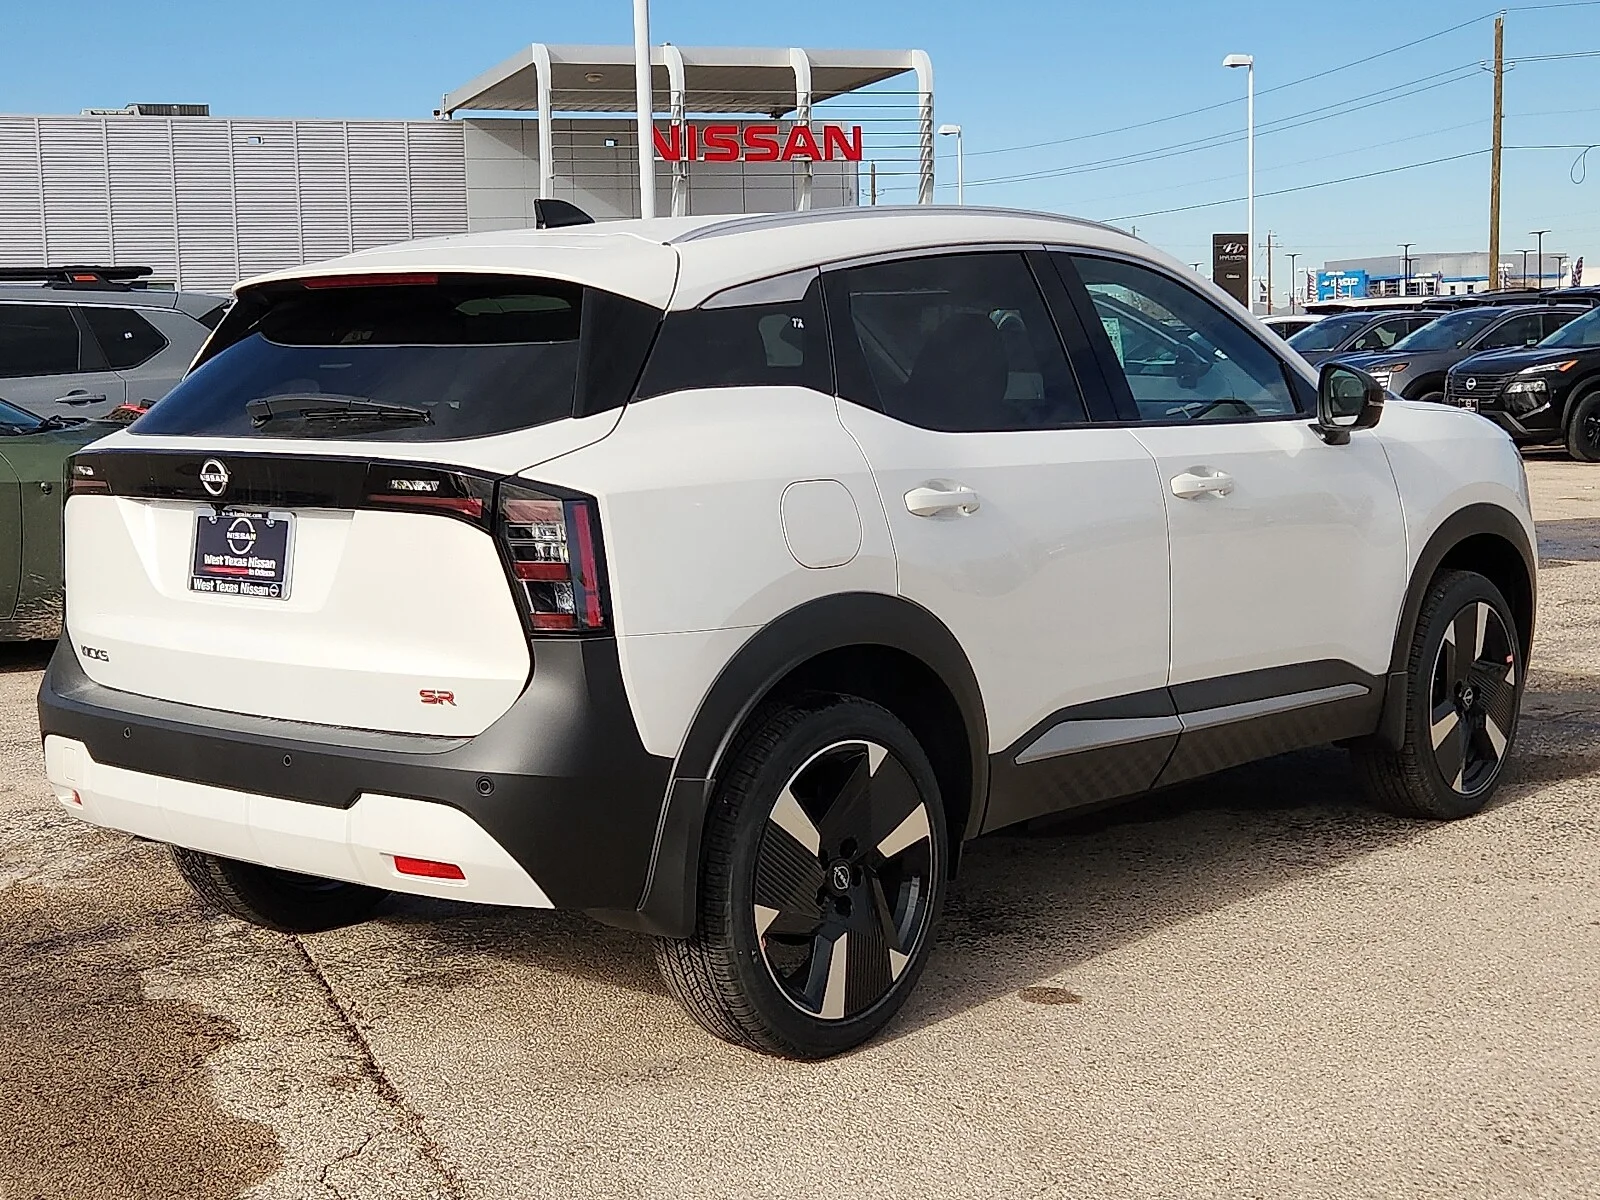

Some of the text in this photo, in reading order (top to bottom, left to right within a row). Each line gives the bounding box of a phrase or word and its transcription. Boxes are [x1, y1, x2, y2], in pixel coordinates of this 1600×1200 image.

[653, 124, 862, 162] NISSAN
[226, 531, 257, 541] NISSAN
[204, 554, 276, 569] West Texas Nissan
[193, 578, 269, 596] West Texas Nissan
[419, 689, 457, 707] SR
